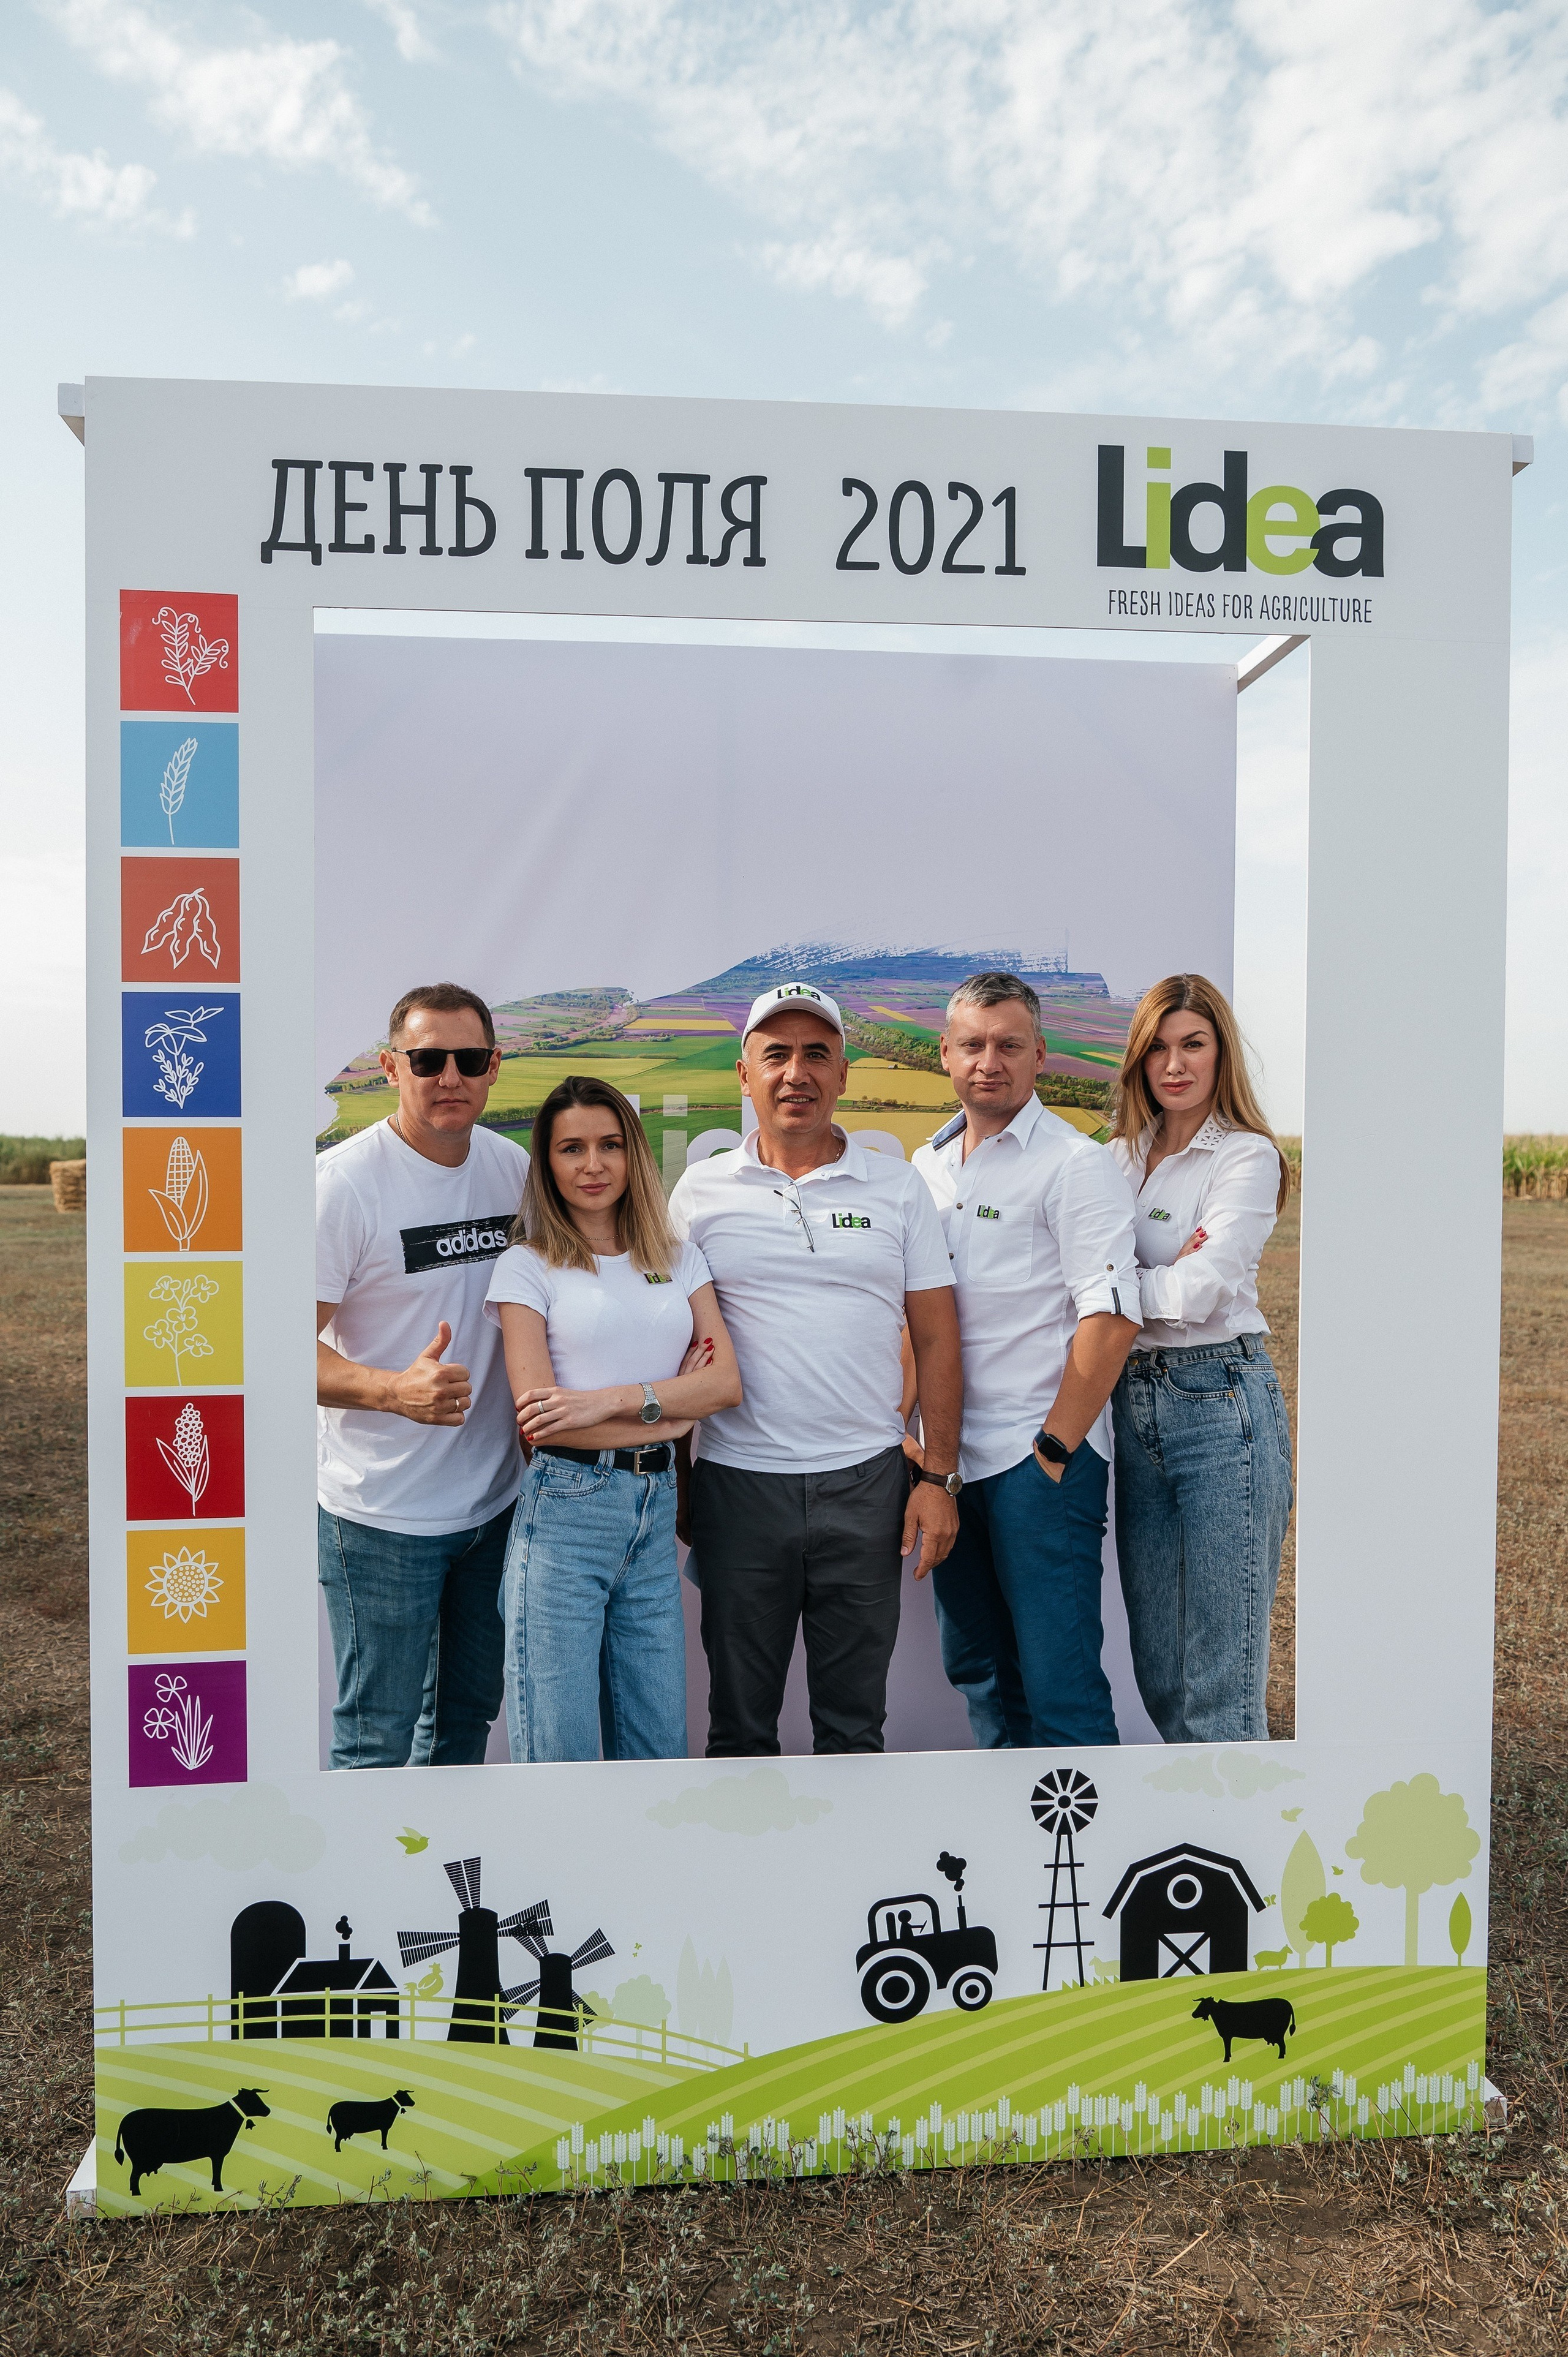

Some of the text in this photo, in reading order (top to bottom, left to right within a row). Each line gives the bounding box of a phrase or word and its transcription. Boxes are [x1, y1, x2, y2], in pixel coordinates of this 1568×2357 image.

[260, 459, 1027, 576] ДЕНЬ ПОЛЯ 2021
[1097, 444, 1384, 578] Lidea
[1108, 589, 1373, 623] FRESH IDEAS FOR AGRICULTURE
[777, 986, 821, 1002] Lidea
[831, 1212, 872, 1229] Lidea
[435, 1227, 508, 1257] adidas
